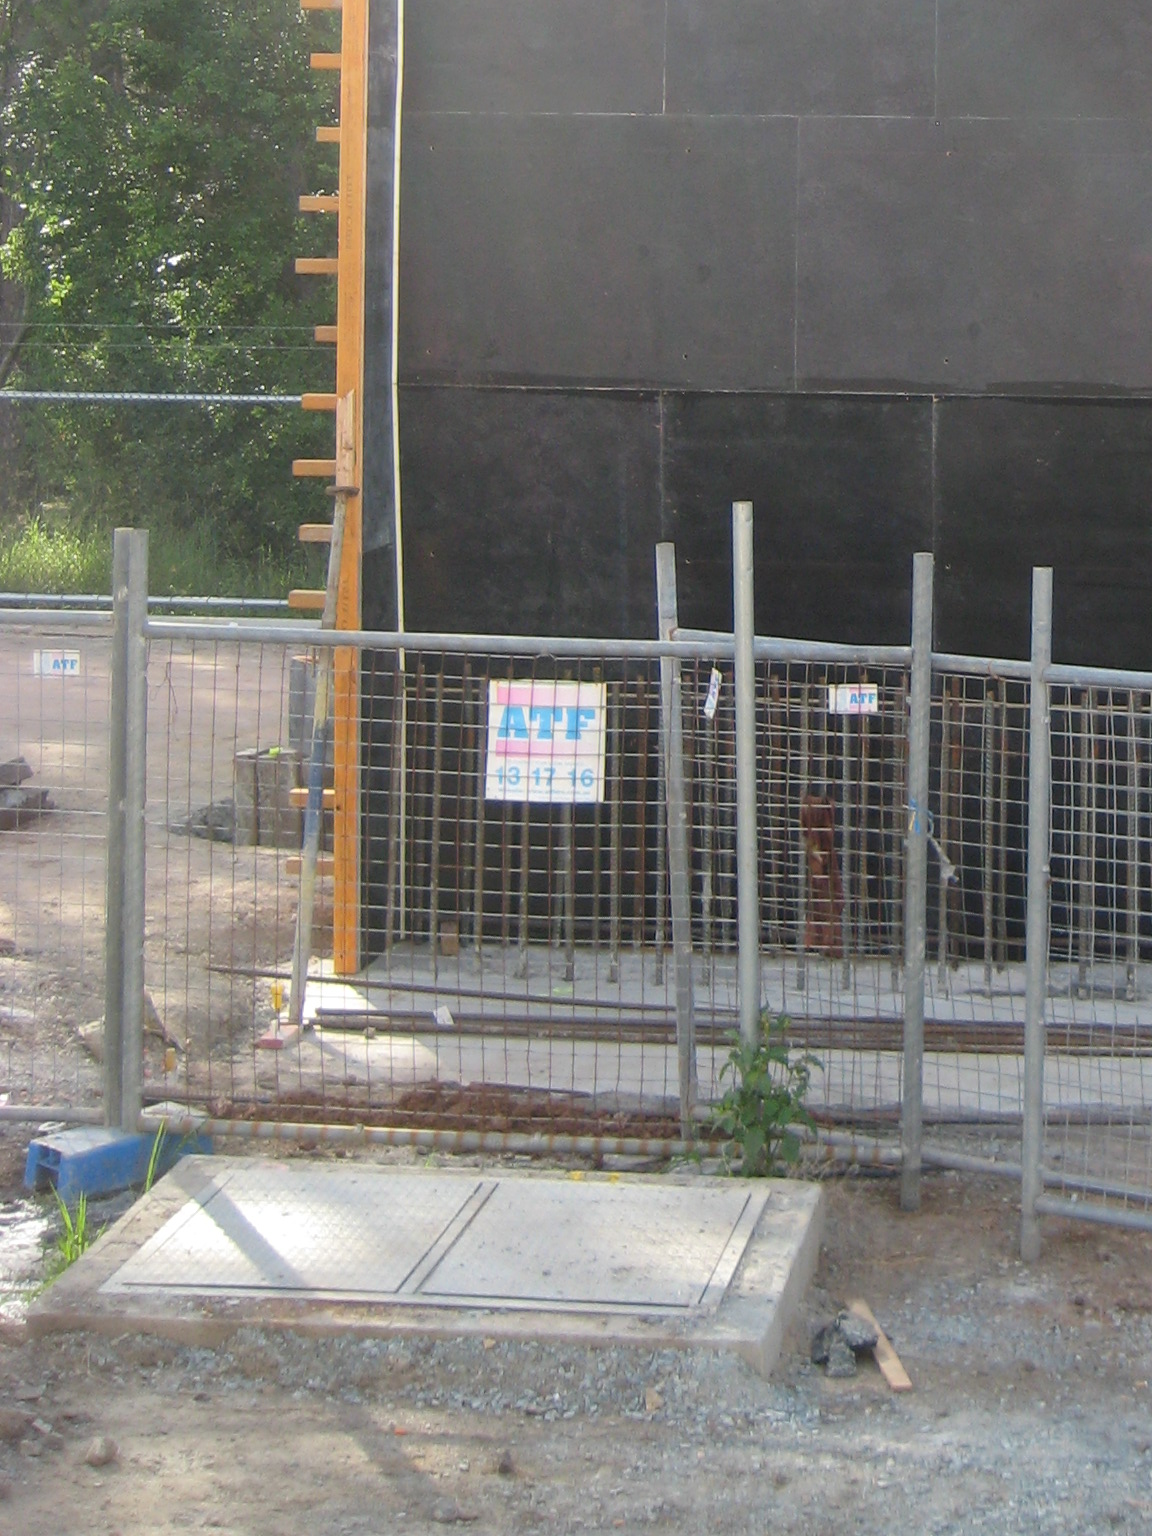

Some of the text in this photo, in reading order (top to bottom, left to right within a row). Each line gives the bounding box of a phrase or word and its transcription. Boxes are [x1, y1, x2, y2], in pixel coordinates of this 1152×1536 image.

[52, 659, 78, 670] ATF
[850, 693, 877, 704] ATF
[497, 706, 596, 740] ATF
[495, 765, 595, 789] 13 17 16
